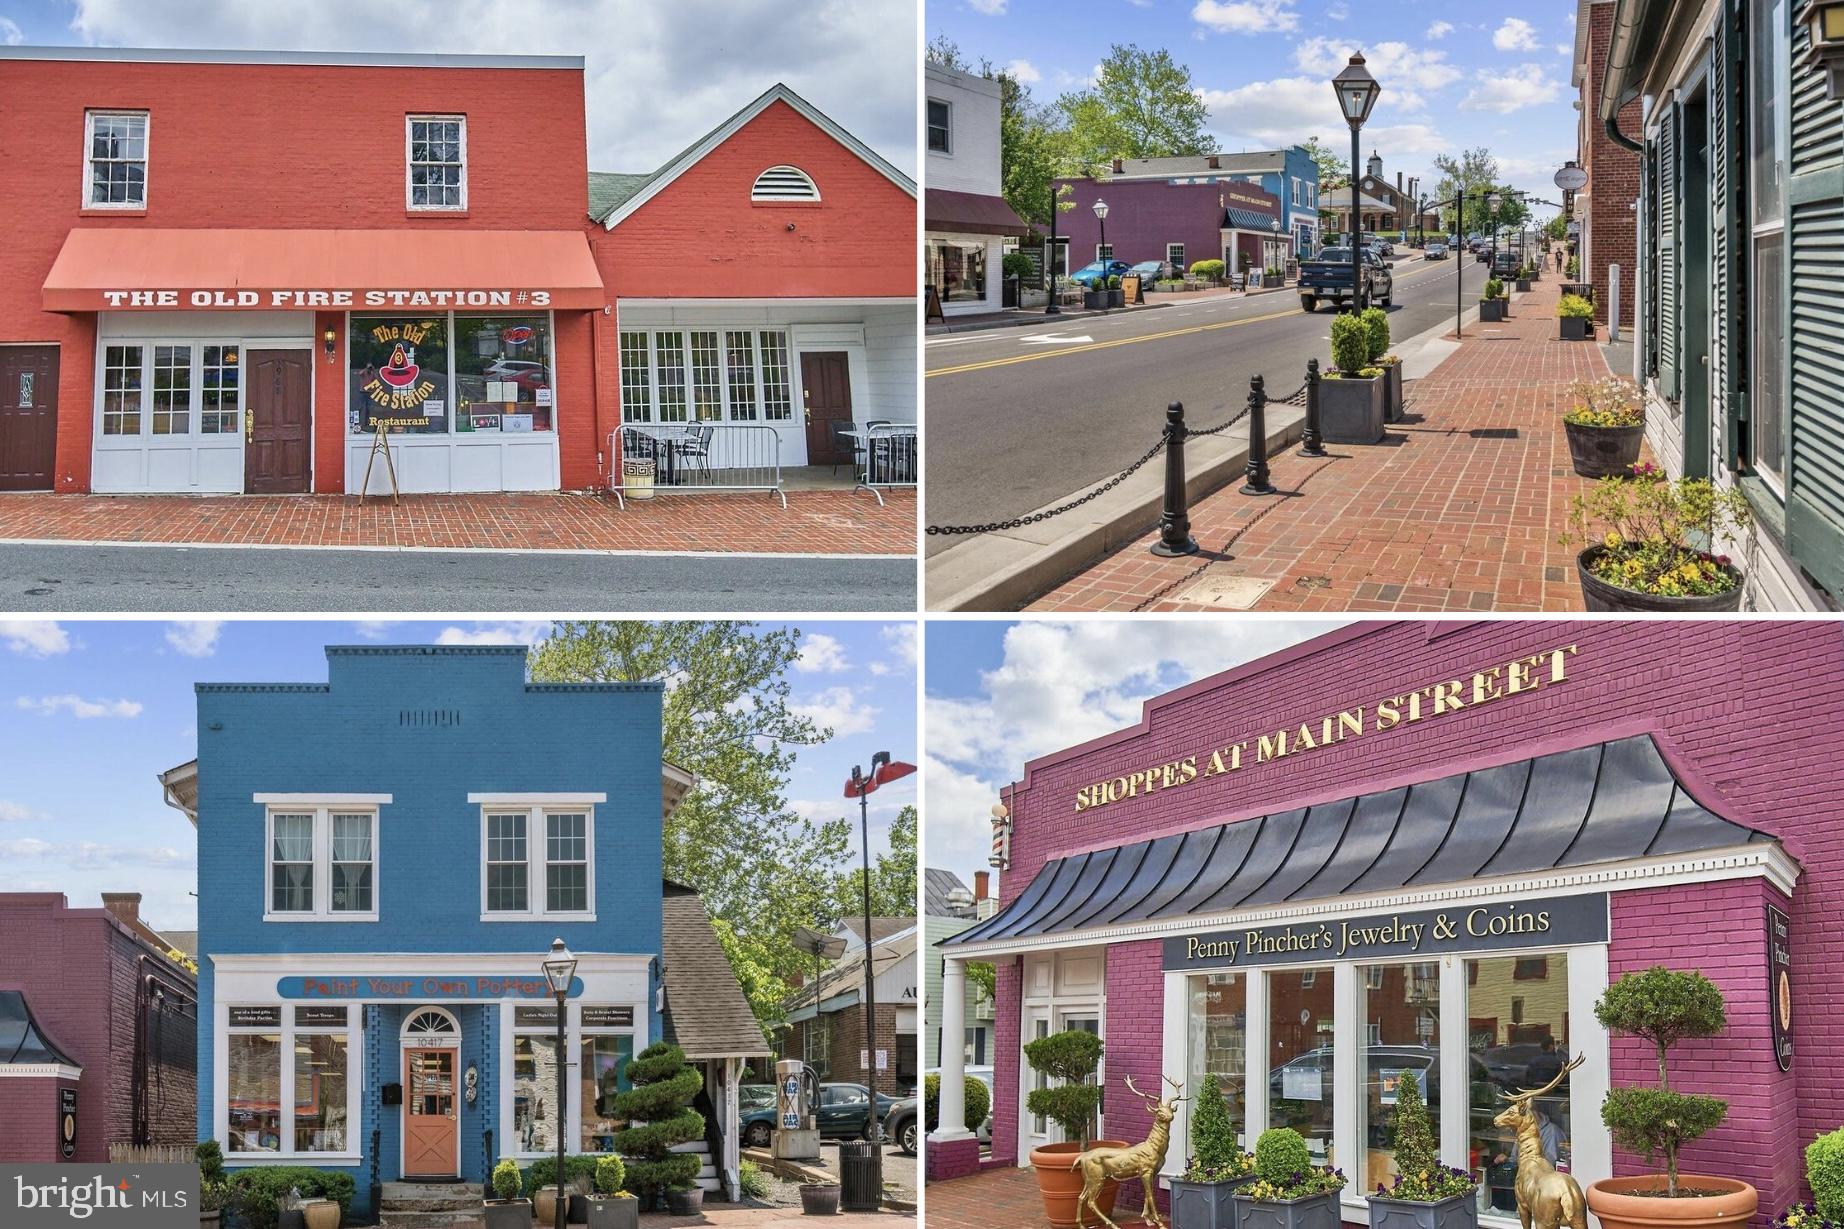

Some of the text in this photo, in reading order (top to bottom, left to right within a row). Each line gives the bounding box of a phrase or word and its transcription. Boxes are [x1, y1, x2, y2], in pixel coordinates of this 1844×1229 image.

[104, 291, 550, 306] THE OLD FIRE STATION #3
[373, 323, 426, 345] The Old
[364, 379, 390, 407] Fire
[390, 381, 435, 409] Station
[369, 416, 430, 426] Rstaurant
[1075, 645, 1578, 811] SHOPPES AT MAIN STREET
[1186, 904, 1551, 964] Penny Pincher's Jewelry & Coins
[304, 977, 359, 995] Paint
[367, 977, 415, 995] Your
[423, 977, 469, 994] Own
[418, 1038, 443, 1047] 10417
